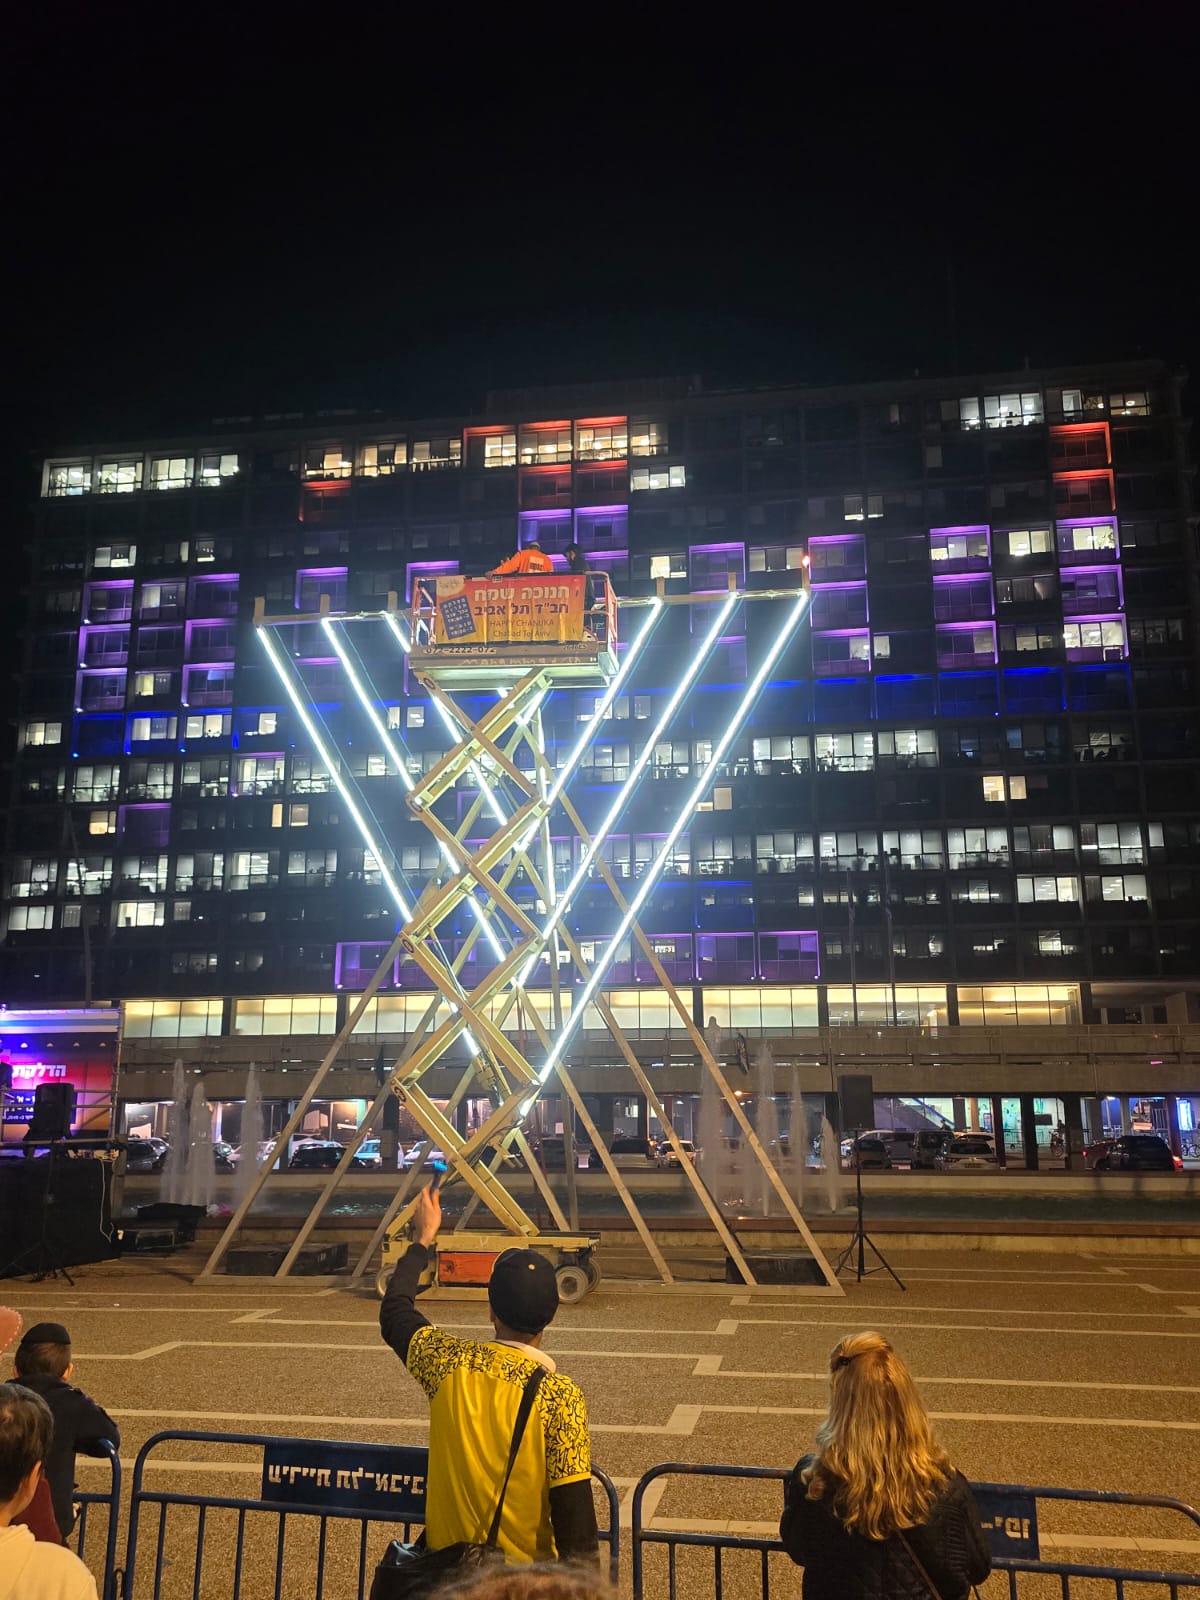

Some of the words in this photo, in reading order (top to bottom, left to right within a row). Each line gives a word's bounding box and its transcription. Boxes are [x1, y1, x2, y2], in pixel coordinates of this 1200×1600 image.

[474, 587, 515, 601] שמח
[521, 586, 570, 599] חנוכה
[474, 604, 506, 616] אביב
[511, 602, 530, 614] תל
[534, 602, 569, 614] חב"ד
[493, 629, 521, 637] Chaad
[12, 1062, 67, 1079] הדלקת
